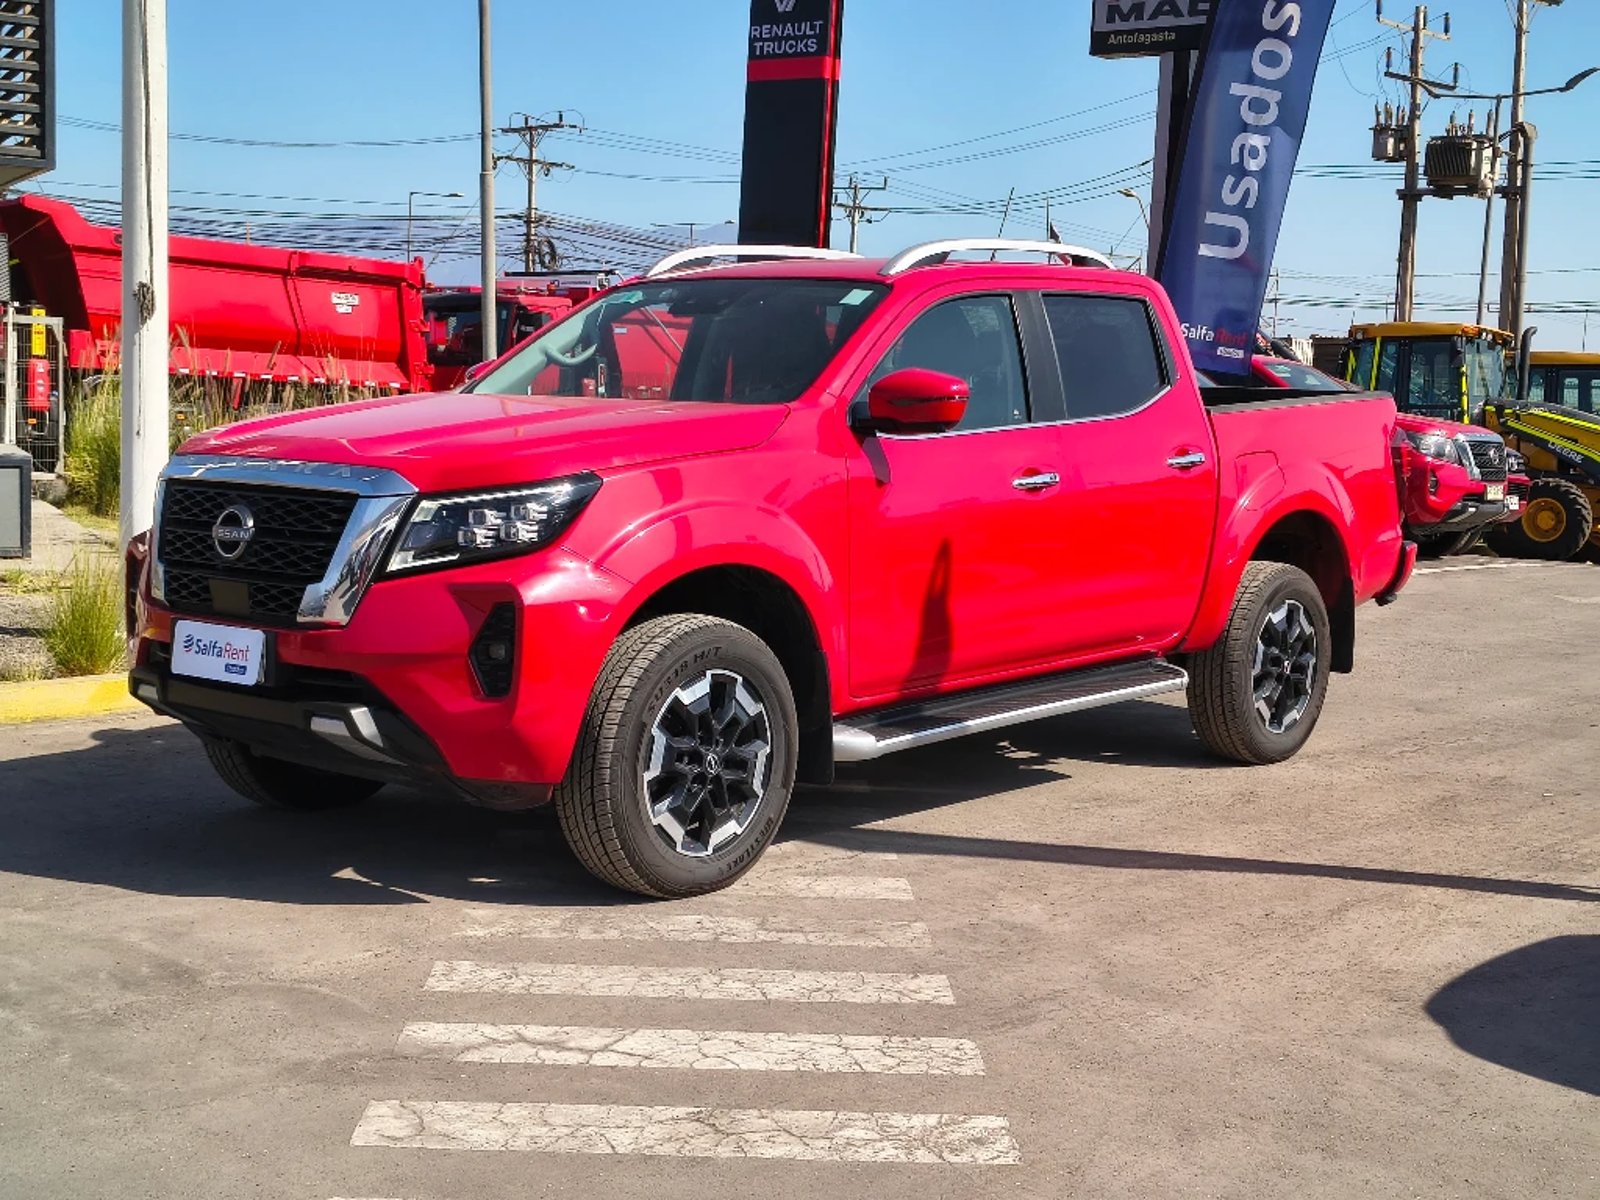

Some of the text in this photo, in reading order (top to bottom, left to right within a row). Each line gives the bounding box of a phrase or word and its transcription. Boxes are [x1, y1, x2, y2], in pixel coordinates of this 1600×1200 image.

[751, 20, 824, 39] RENAULT
[1107, 30, 1176, 45] Antofagasta
[753, 38, 818, 56] TRUCKS
[1198, 0, 1301, 260] Usados
[194, 639, 251, 662] SalfaRent
[693, 646, 722, 664] H/T
